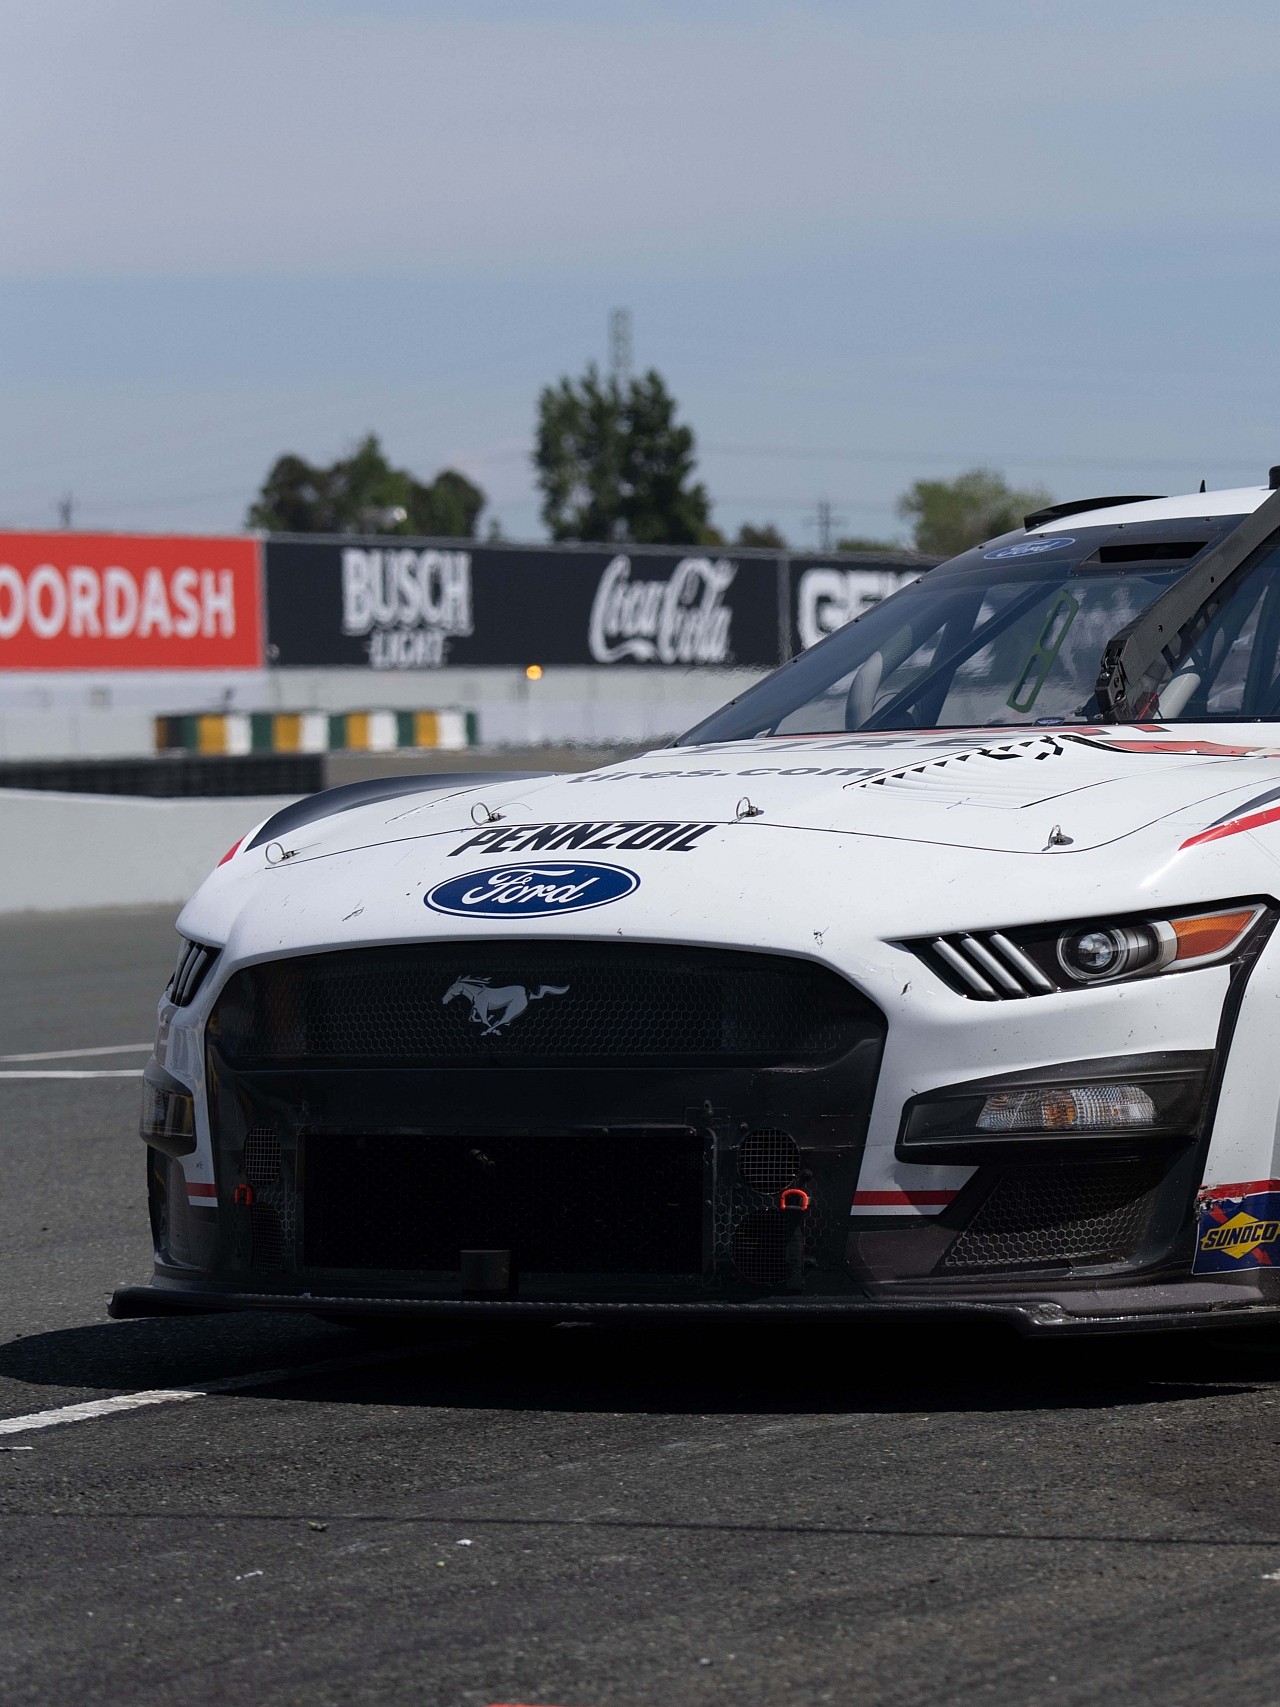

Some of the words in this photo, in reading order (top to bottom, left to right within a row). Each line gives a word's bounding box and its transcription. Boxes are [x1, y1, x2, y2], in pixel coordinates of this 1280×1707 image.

[340, 548, 474, 637] BUSCH
[566, 766, 886, 784] tires.com
[446, 823, 719, 857] PENNZOIL
[461, 868, 600, 904] Ford
[1203, 1222, 1280, 1249] SUNOCO
